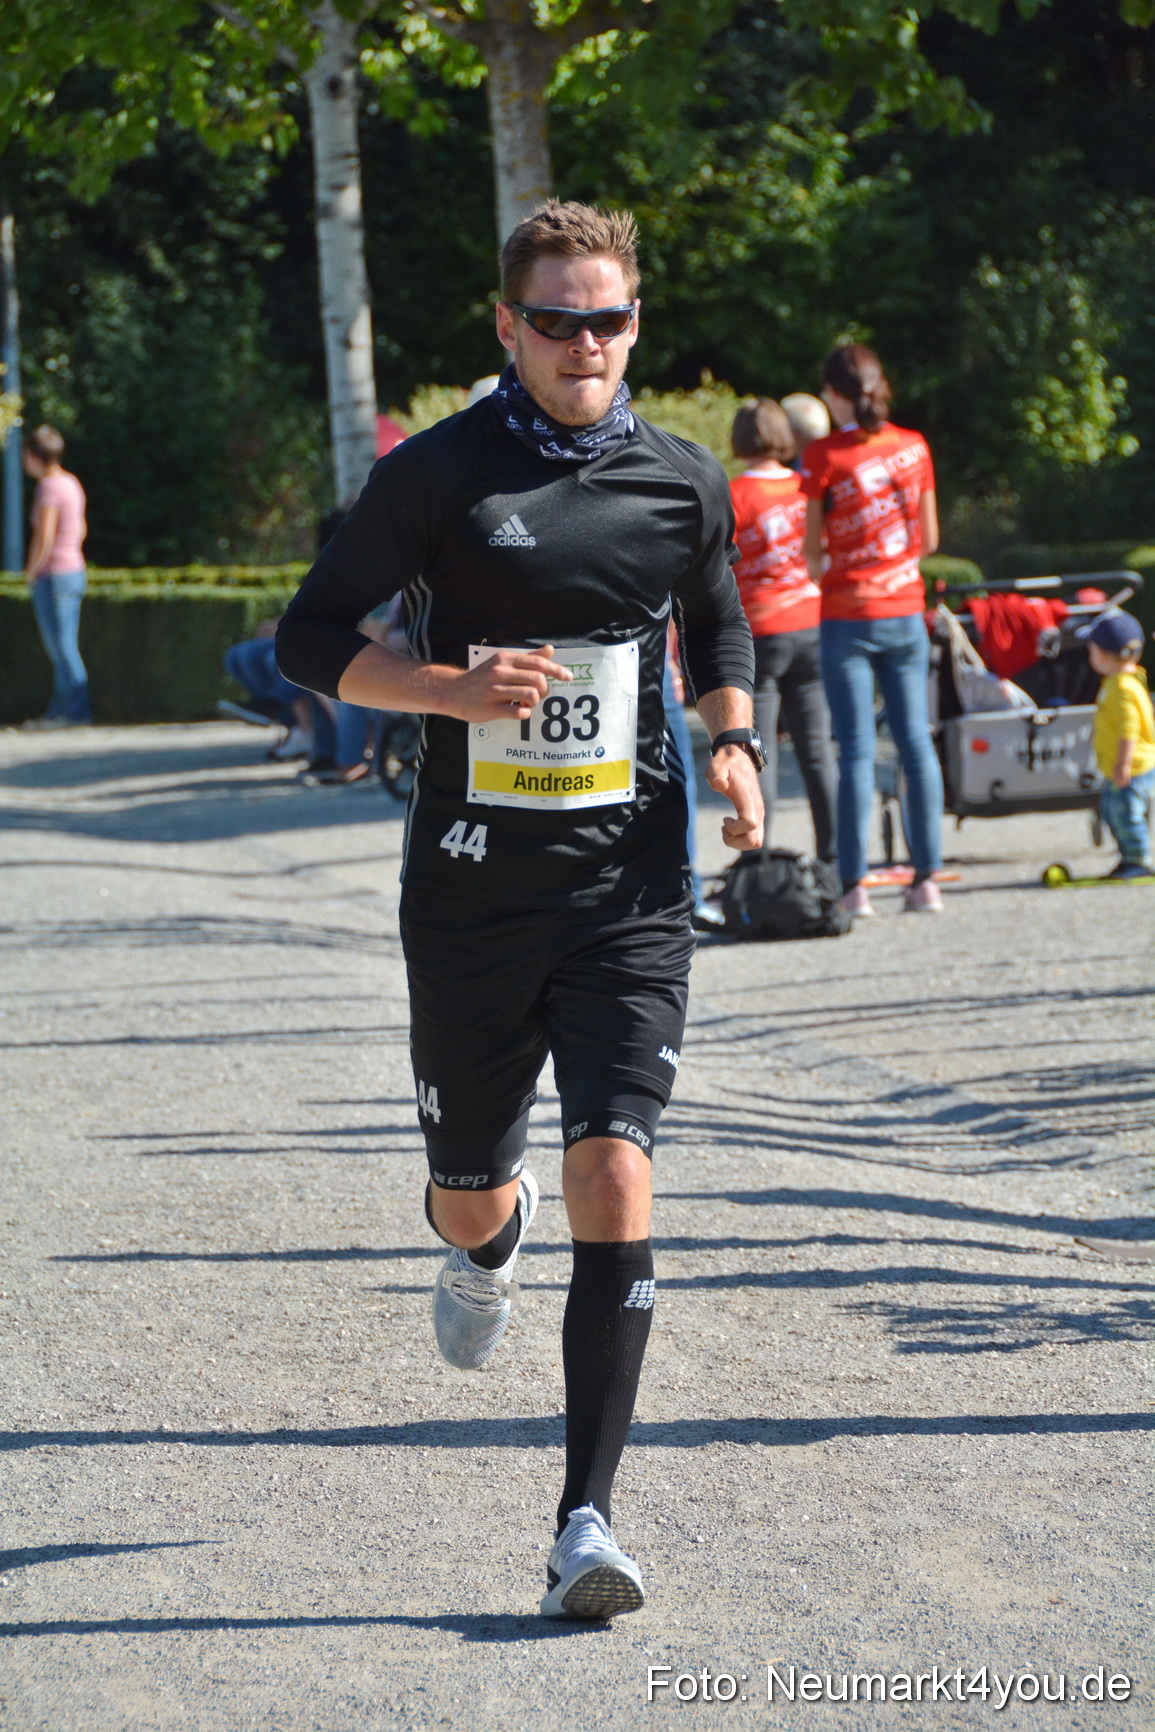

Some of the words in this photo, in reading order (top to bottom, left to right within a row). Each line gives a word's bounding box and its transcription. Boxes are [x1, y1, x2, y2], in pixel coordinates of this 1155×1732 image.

[488, 534, 536, 547] adidas
[478, 728, 485, 738] C
[506, 748, 540, 760] PARTL
[543, 750, 591, 761] Neumarkt
[513, 770, 594, 792] Andreas
[440, 820, 488, 862] 44
[658, 1045, 680, 1070] JAK
[419, 1079, 441, 1123] 44
[627, 1125, 651, 1148] cep
[447, 1174, 489, 1189] cep
[623, 1299, 654, 1310] cep
